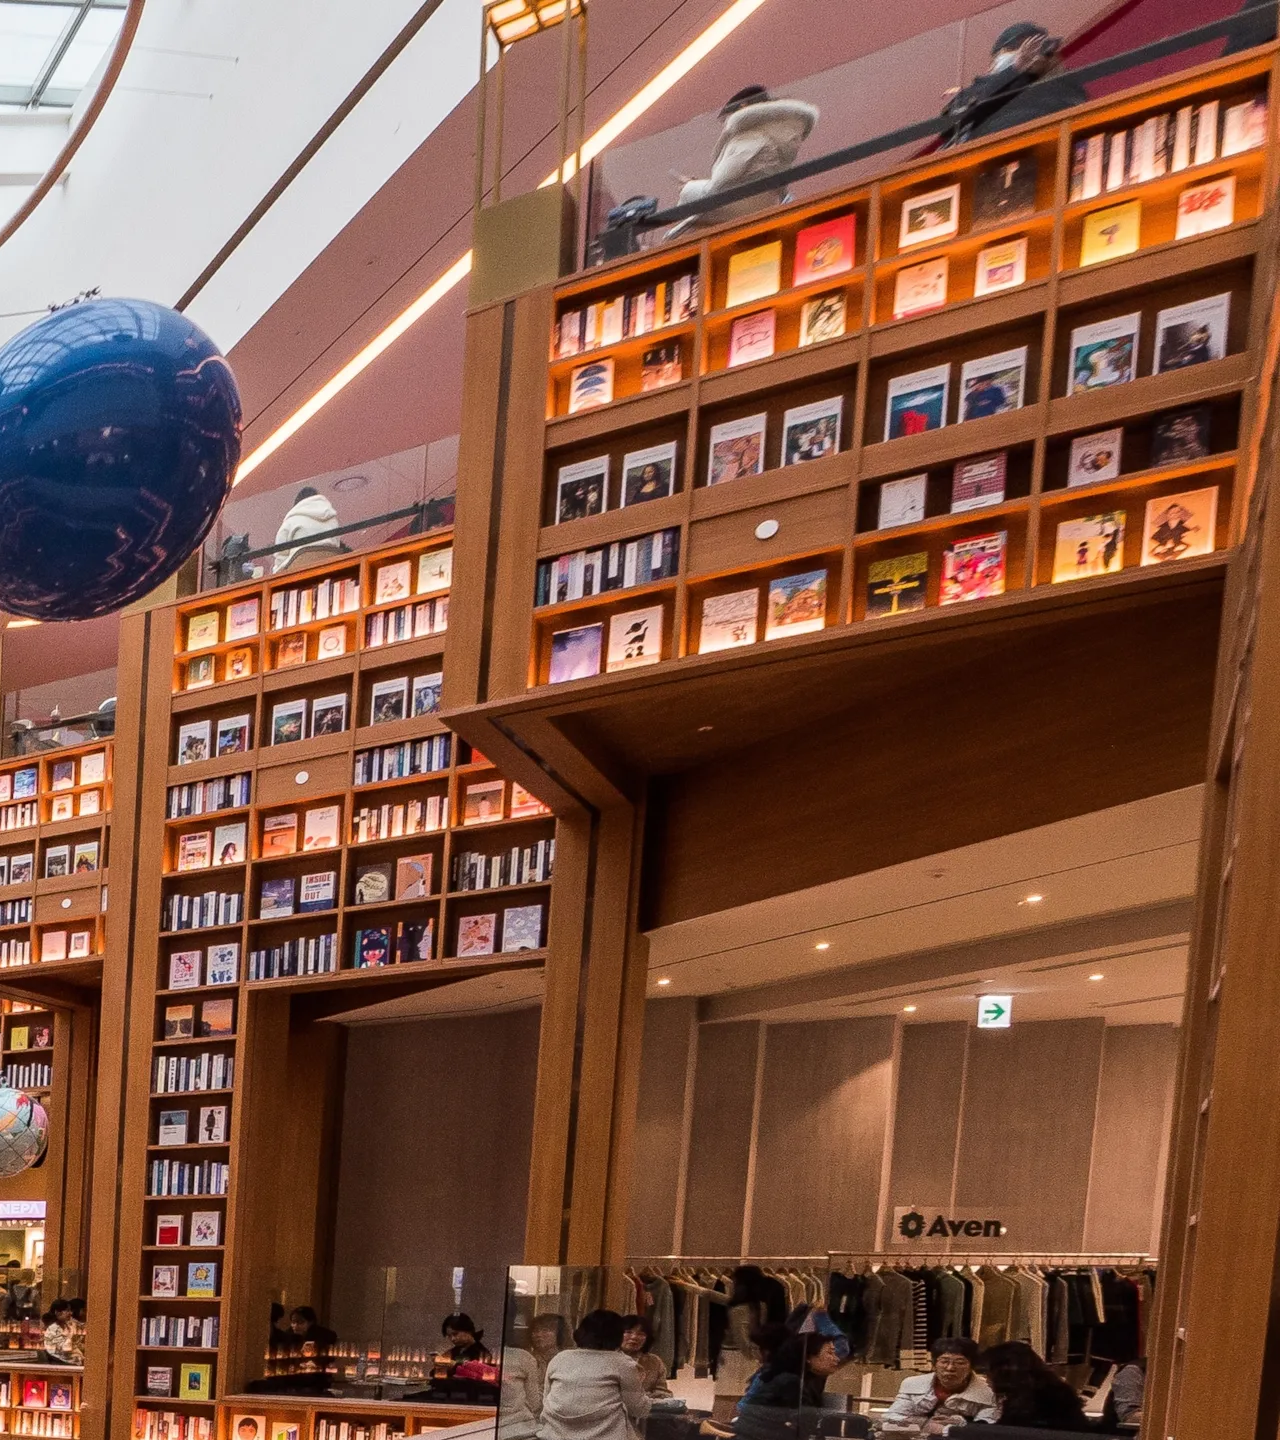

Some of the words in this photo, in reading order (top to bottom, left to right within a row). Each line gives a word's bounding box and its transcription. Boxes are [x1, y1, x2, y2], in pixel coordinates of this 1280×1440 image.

[305, 873, 332, 885] INSIDE
[304, 891, 321, 901] OUT
[0, 1203, 41, 1215] NEPA
[926, 1214, 1002, 1238] Aven
